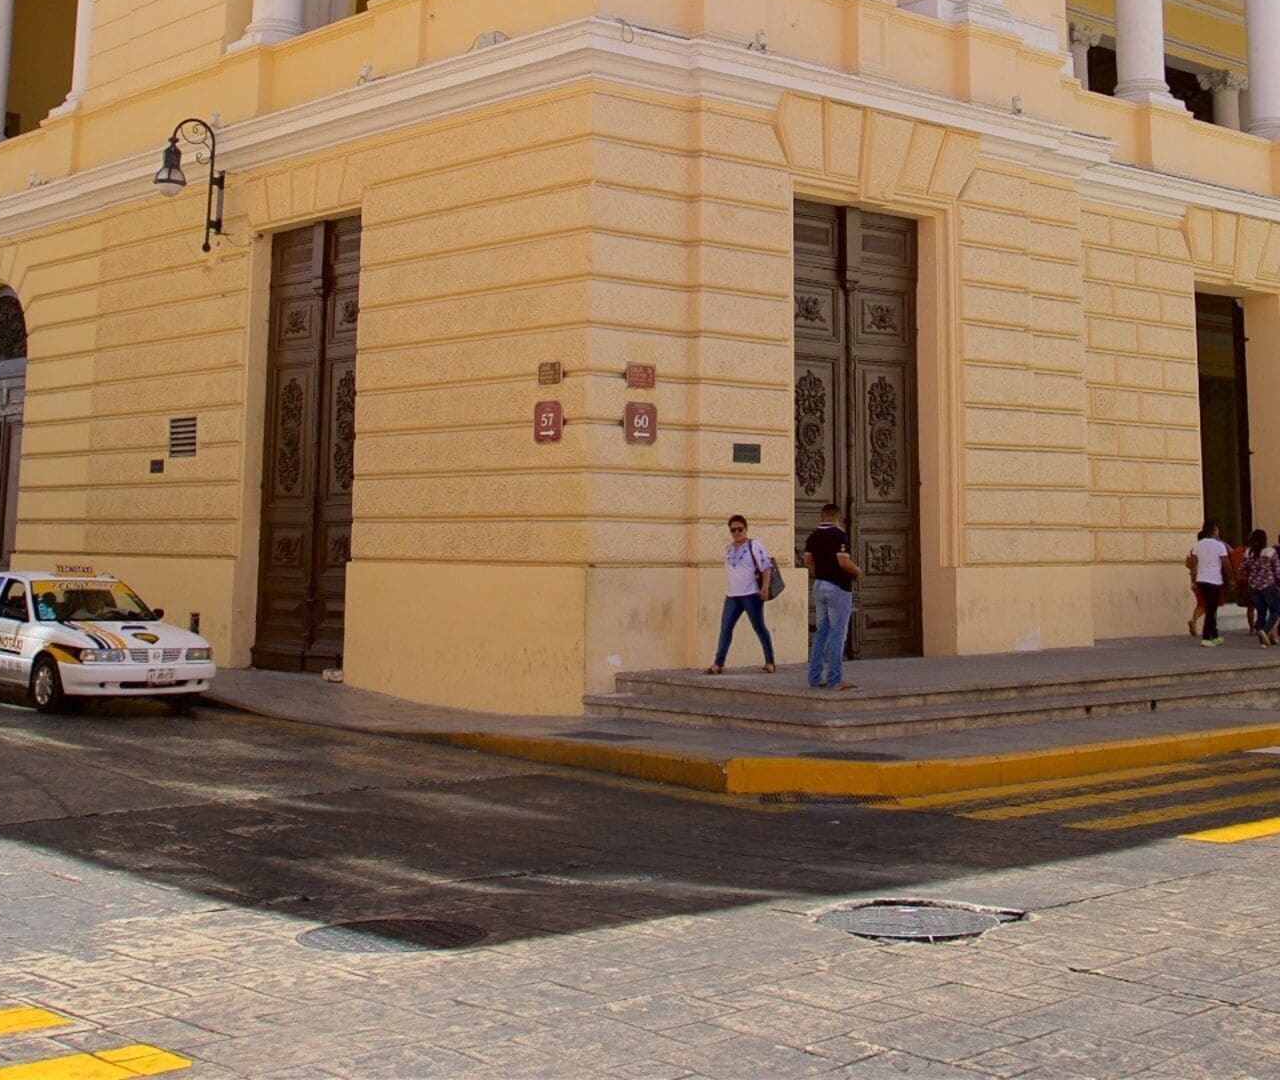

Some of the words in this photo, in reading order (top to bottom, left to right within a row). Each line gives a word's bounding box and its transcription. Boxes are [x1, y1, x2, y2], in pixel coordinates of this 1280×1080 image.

[540, 413, 554, 427] 57
[634, 414, 649, 428] 60
[56, 564, 93, 574] TECNOTAXI
